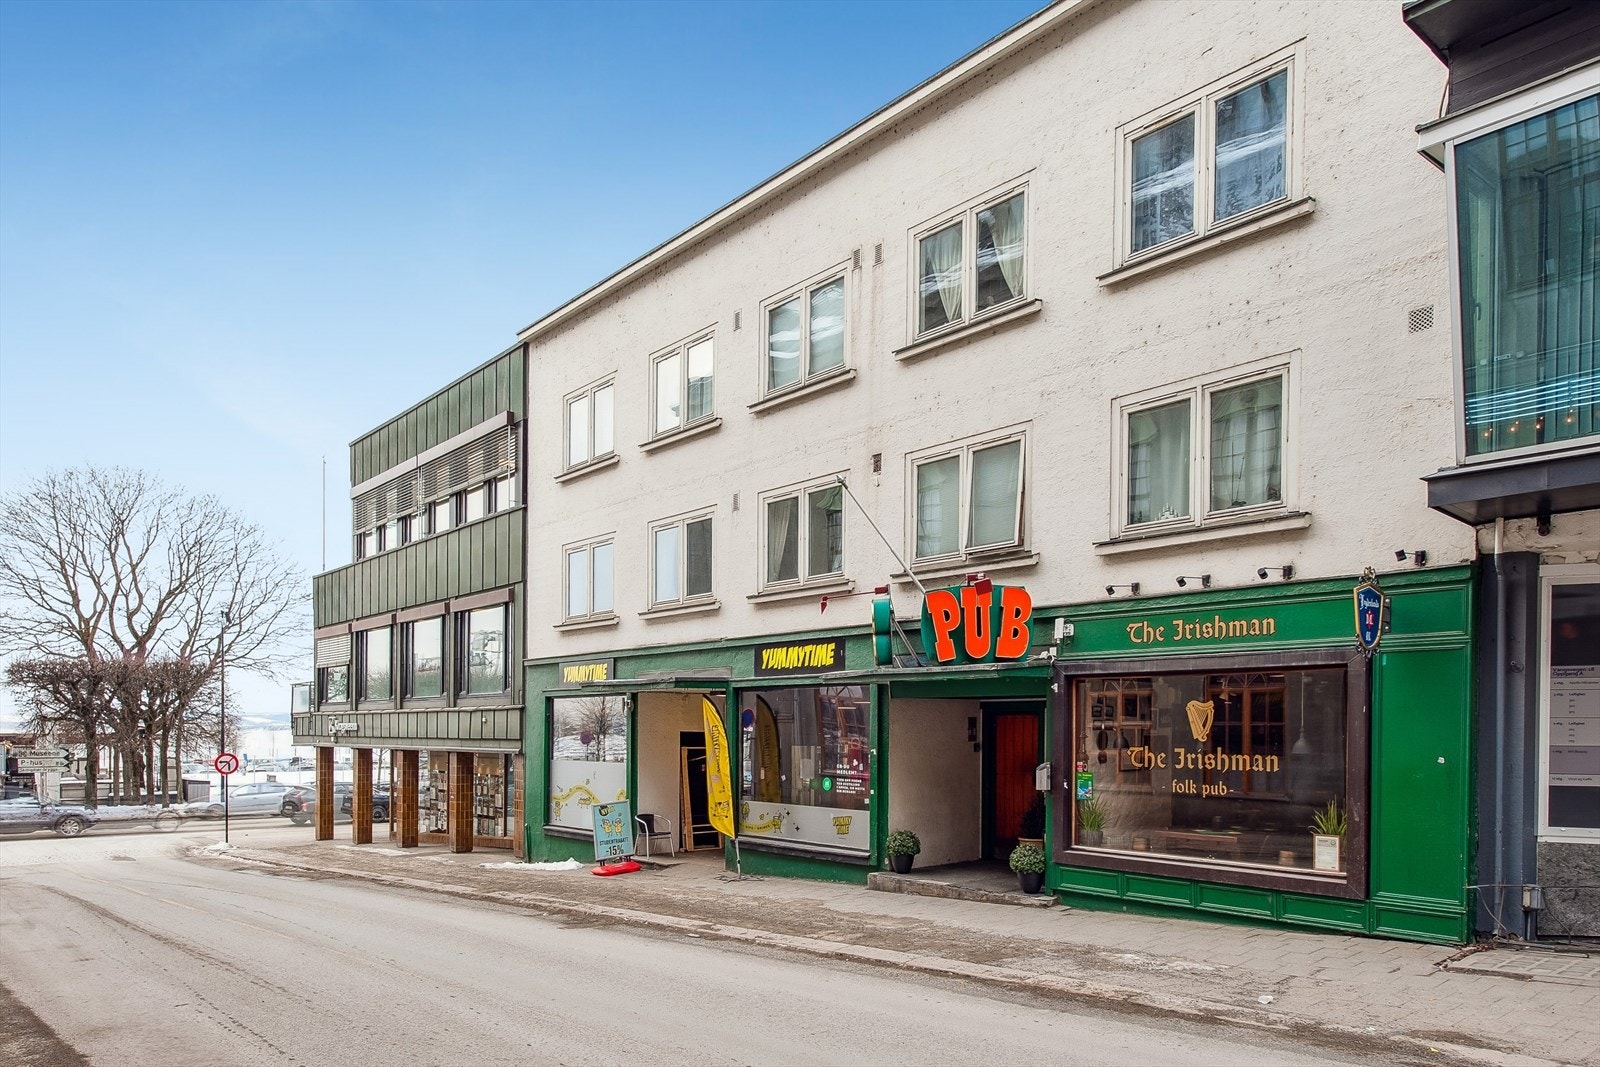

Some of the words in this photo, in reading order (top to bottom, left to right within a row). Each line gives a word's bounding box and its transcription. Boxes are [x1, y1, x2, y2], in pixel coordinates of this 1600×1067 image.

[925, 586, 1033, 663] PUB
[1125, 620, 1166, 645] The
[1172, 614, 1276, 642] Irishman
[761, 642, 836, 670] YUMMYTIME
[563, 663, 608, 683] YUMMYTIME
[1126, 745, 1167, 771] The
[1174, 746, 1280, 773] Irishman
[1172, 778, 1197, 794] folk
[605, 843, 625, 857] -15%
